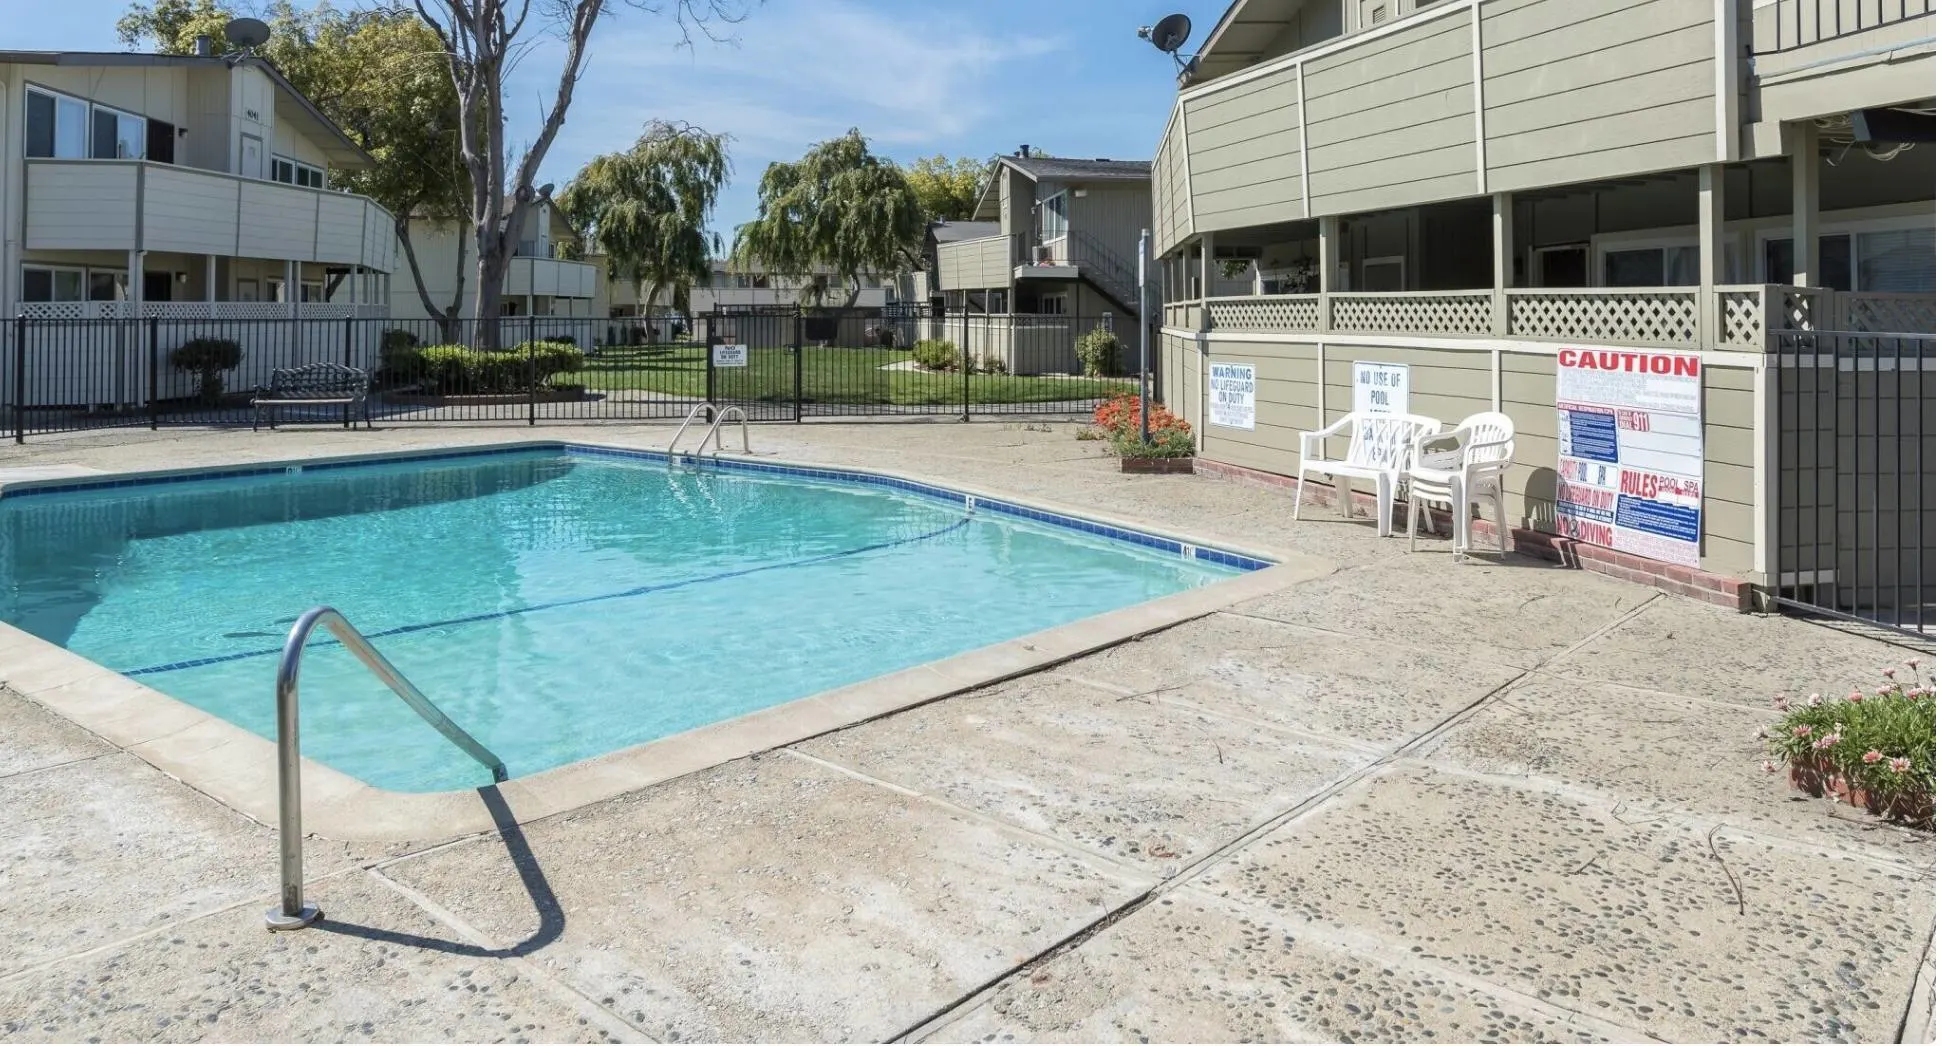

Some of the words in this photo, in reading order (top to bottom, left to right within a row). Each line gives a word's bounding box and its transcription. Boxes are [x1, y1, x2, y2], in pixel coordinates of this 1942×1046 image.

[1559, 350, 1698, 377] CAUTION
[1212, 366, 1252, 380] WARNING
[1360, 371, 1371, 385] NO
[1374, 372, 1388, 387] USE
[1391, 374, 1401, 388] OF
[1211, 379, 1220, 390] NO
[1221, 379, 1254, 393] LIFEGUARD
[1219, 391, 1227, 402] ON
[1229, 392, 1244, 404] DUTY
[1371, 390, 1390, 405] POOL
[1633, 412, 1649, 432] 911
[1620, 470, 1658, 498] RULES
[1659, 476, 1679, 489] POOL
[1683, 480, 1698, 492] SPA
[1556, 514, 1568, 535] NO
[1581, 520, 1612, 547] DIVING
